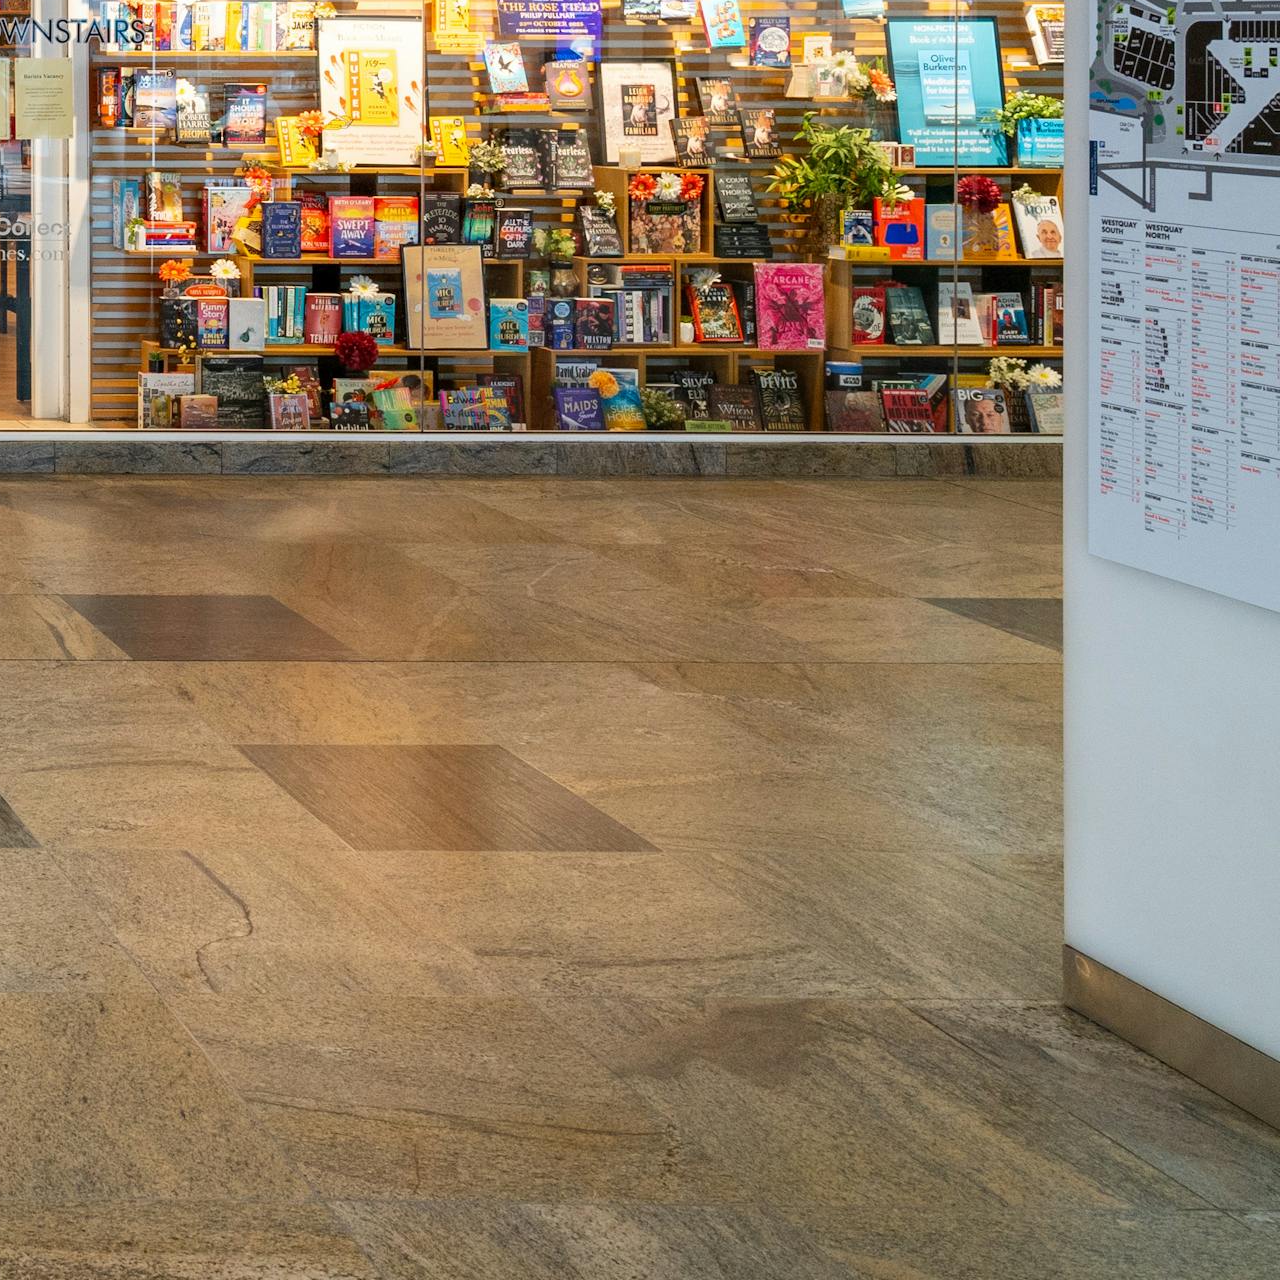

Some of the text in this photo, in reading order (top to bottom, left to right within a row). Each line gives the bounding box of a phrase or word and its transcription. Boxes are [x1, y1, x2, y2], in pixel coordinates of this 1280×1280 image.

[501, 2, 599, 12] THE ROSE FIELD
[292, 21, 313, 30] JAMES
[913, 24, 969, 33] NON-FICTION
[930, 54, 956, 63] Olive
[923, 62, 967, 71] Burkeman
[349, 52, 361, 120] BUTTER
[179, 113, 209, 121] ROBERT
[179, 120, 210, 129] HARRIS
[180, 129, 210, 139] PRECIPICE
[625, 127, 657, 135] FAMILIAR
[750, 148, 783, 156] FAMILIAR
[683, 158, 717, 166] FAMILIAR
[337, 220, 371, 230] SWEPT
[1101, 218, 1137, 228] WESTQUAY
[429, 223, 455, 234] HARKIN
[1101, 226, 1124, 235] SOUTH
[1145, 223, 1183, 234] WESTQUAY
[341, 230, 367, 239] AWAY
[1145, 232, 1170, 240] NORTH
[773, 276, 811, 285] ARCANE
[200, 302, 227, 312] Funny
[202, 310, 224, 319] Story
[309, 333, 339, 345] TENANT
[584, 335, 612, 343] PHANTOM
[760, 375, 798, 390] DEVILS
[957, 389, 983, 401] BIG
[447, 396, 483, 405] Edward
[564, 400, 598, 413] MAID'S
[609, 404, 635, 414] SURF
[445, 408, 487, 419] St Aubyn
[606, 413, 642, 422] HOUSE
[890, 408, 930, 419] NOTHING
[335, 422, 369, 431] Orbital
